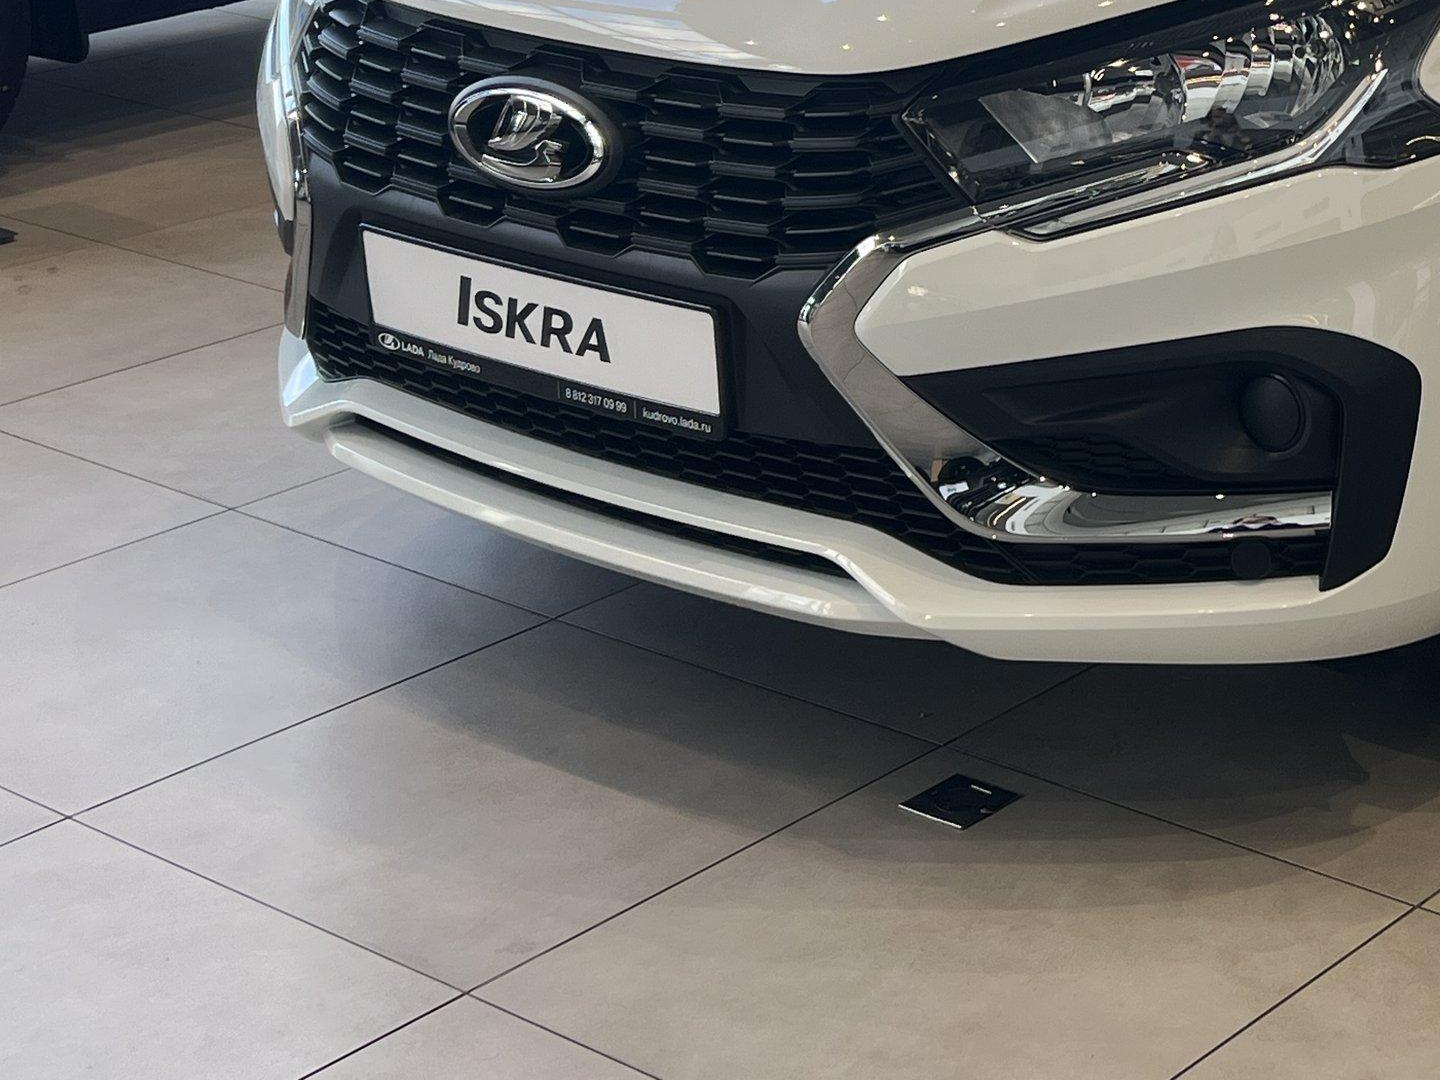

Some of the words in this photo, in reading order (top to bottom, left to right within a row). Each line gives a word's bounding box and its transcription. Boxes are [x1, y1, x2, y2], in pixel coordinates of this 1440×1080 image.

[457, 275, 611, 364] ISKRA
[401, 341, 425, 357] LADA
[573, 389, 588, 404] 812
[588, 393, 602, 407] 317
[603, 398, 615, 411] 09
[642, 407, 712, 434] kudrovo.lada.ru
